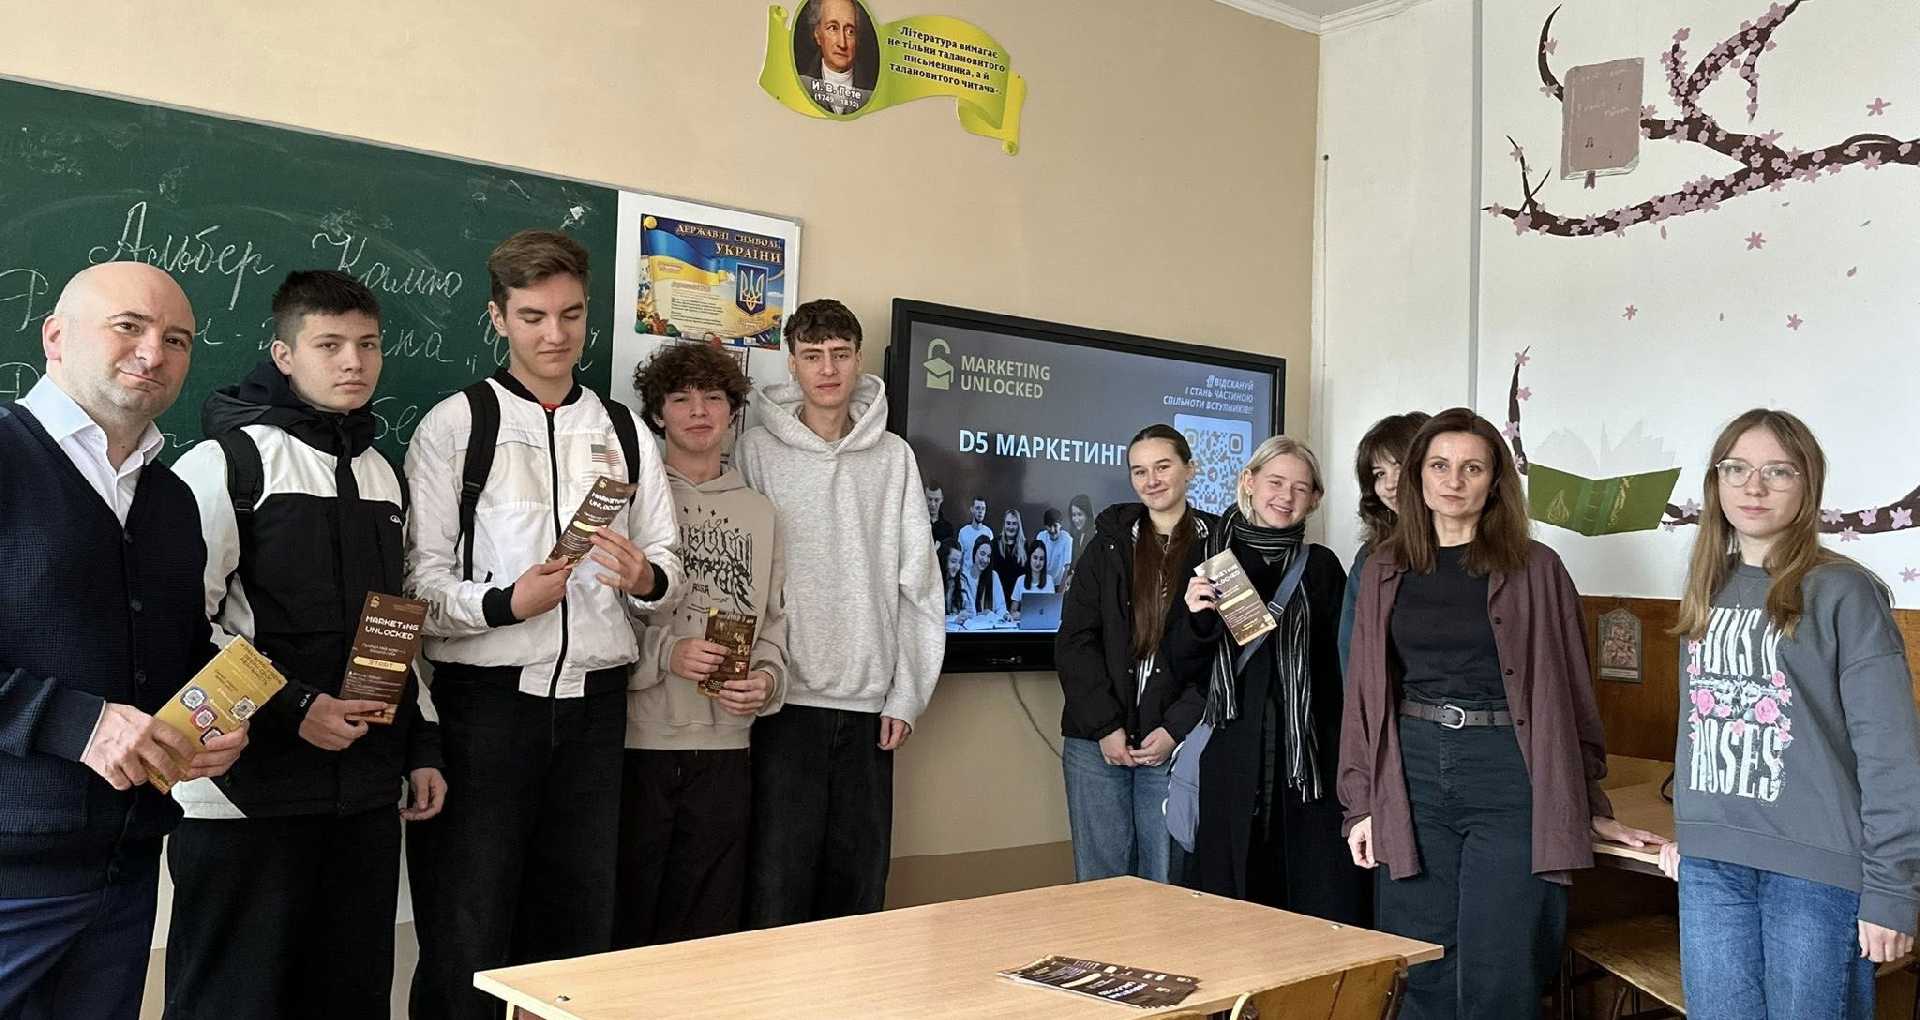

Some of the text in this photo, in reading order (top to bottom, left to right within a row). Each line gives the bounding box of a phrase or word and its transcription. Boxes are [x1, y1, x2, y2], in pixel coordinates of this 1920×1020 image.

[887, 38, 1006, 72] не тільки талановитого
[889, 63, 960, 85] талановитого
[716, 241, 780, 263] УКРАЇНИ
[961, 355, 1050, 381] MARKETING
[960, 374, 1044, 399] UNLOCKED
[1190, 387, 1213, 398] СТАНЬ
[1214, 389, 1254, 403] ЧАСТИНОЮ
[959, 430, 1127, 466] D5 МАРКЕТИНГ
[365, 625, 414, 640] UNLOCKED
